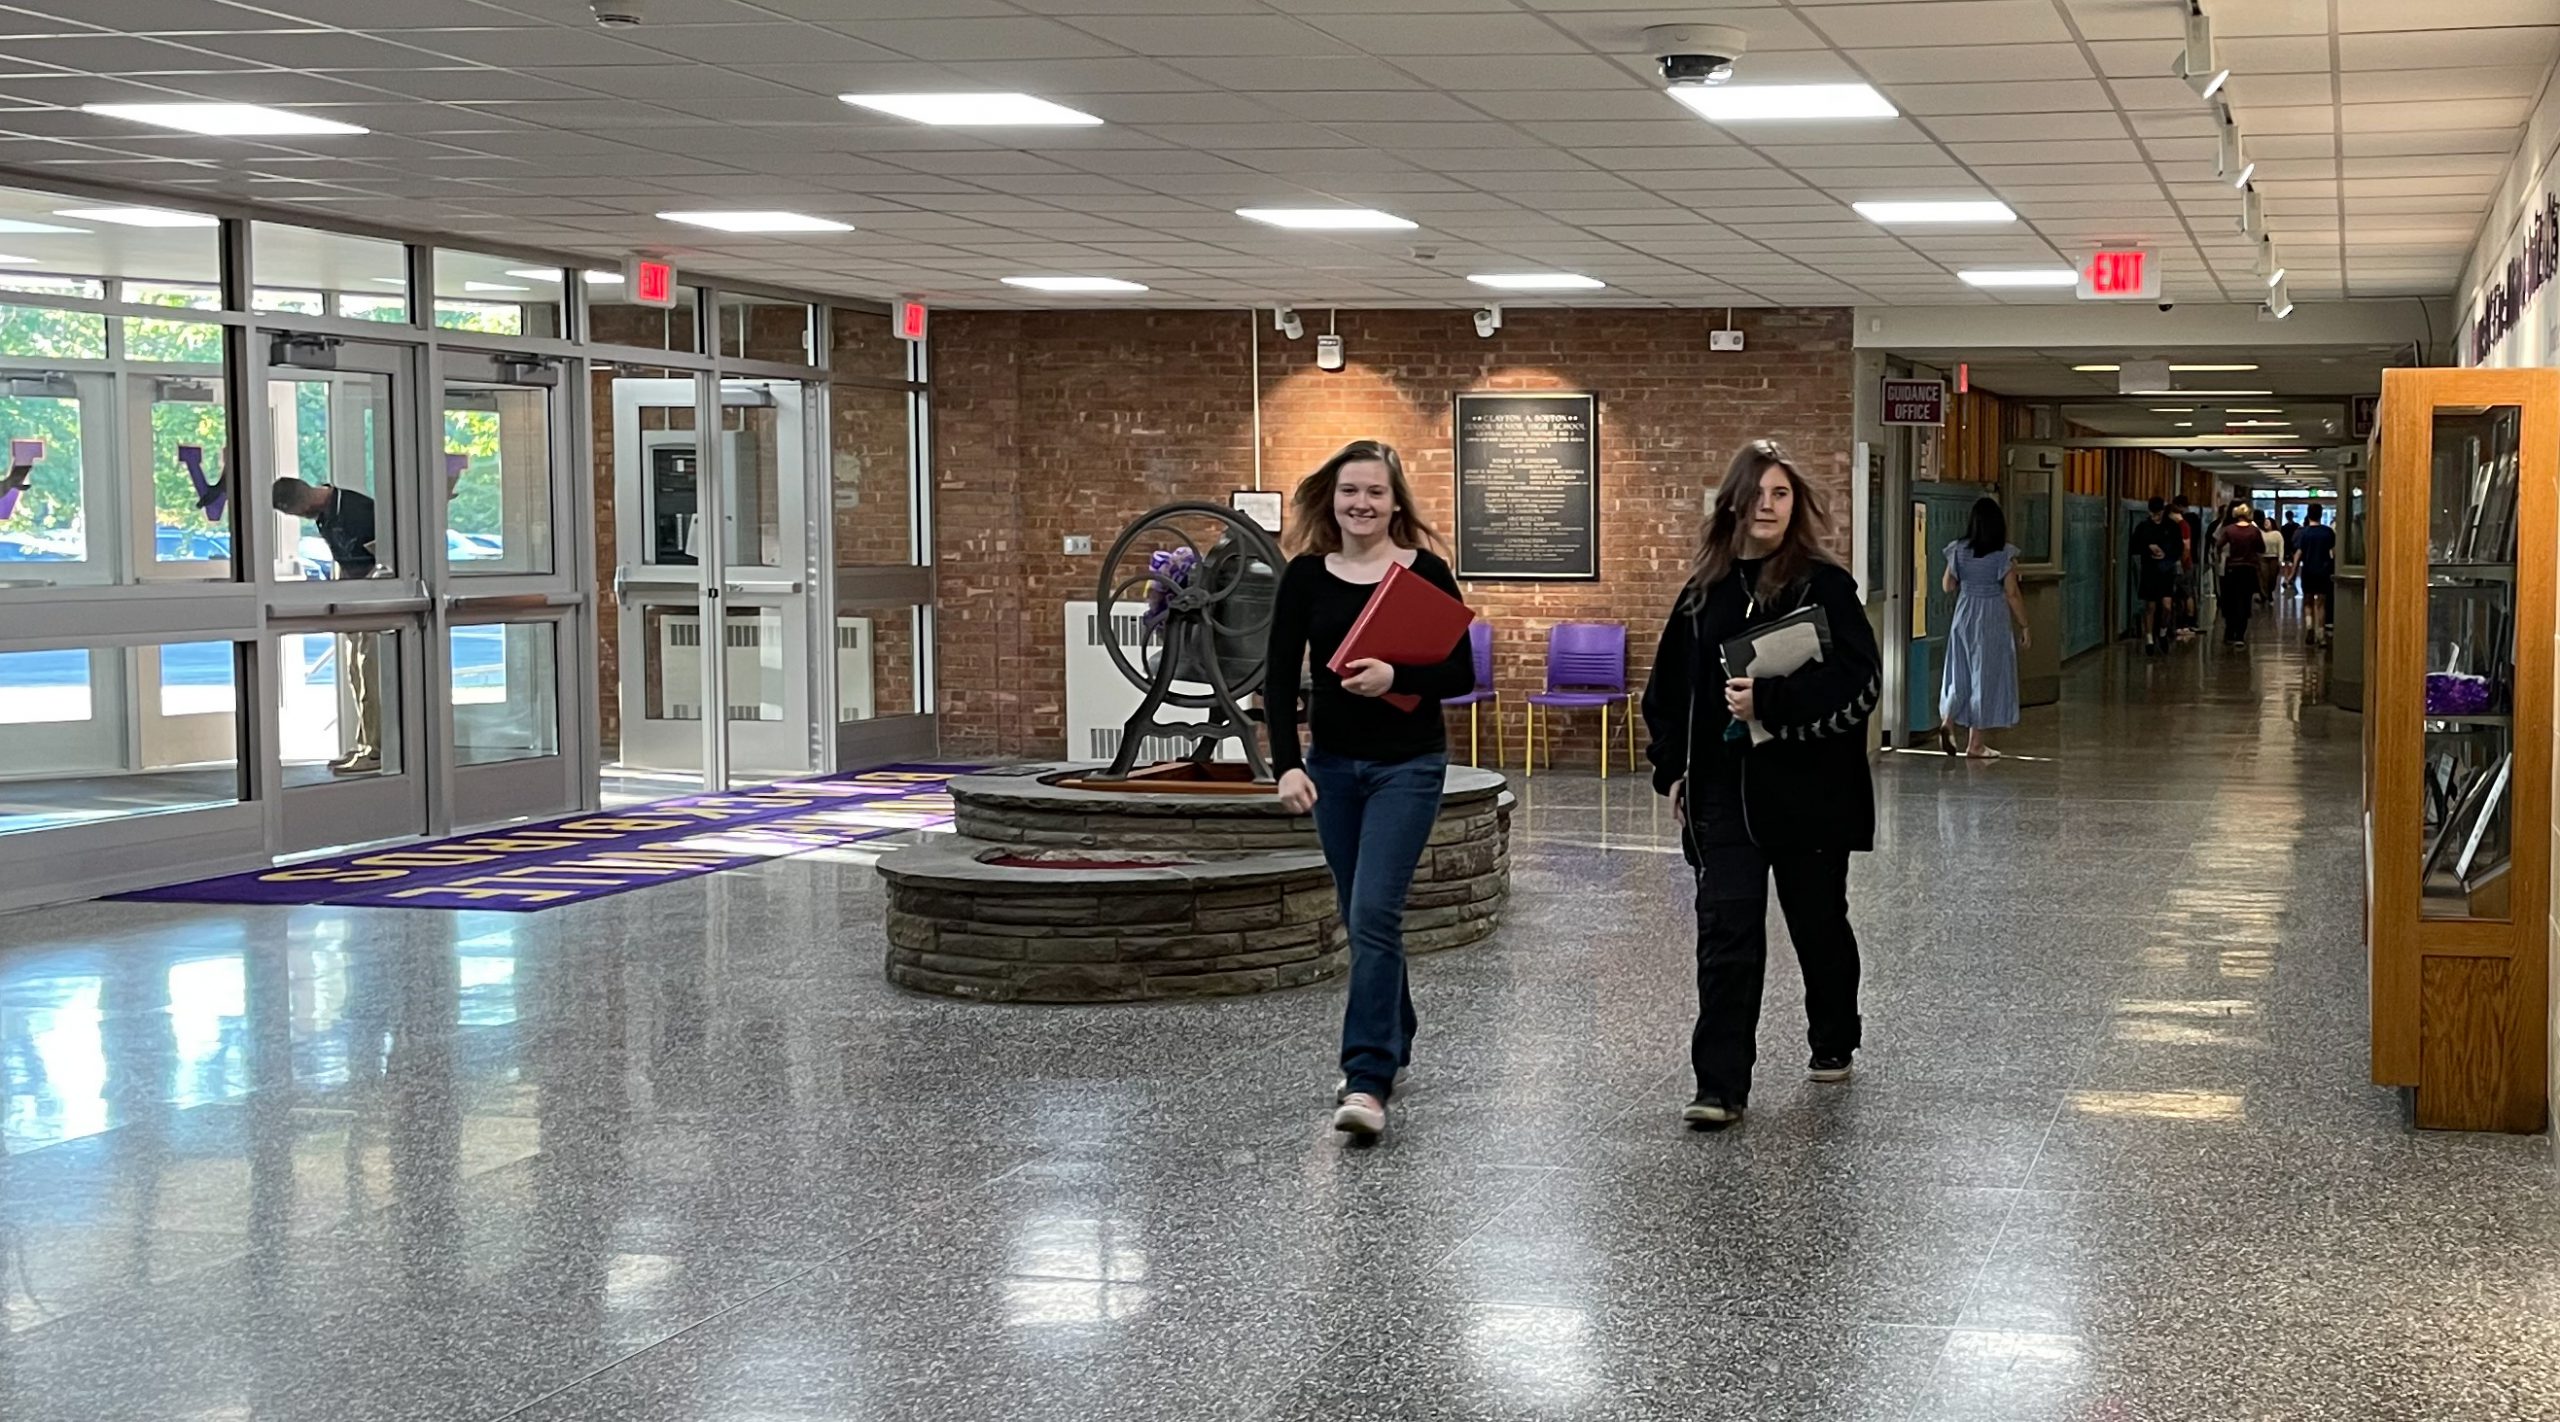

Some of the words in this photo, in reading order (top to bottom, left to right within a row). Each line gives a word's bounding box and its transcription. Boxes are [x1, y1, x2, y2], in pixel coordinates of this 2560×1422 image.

[2094, 251, 2146, 294] EXIT
[1887, 385, 1939, 401] GUIDANCE
[1894, 404, 1931, 420] OFFICE
